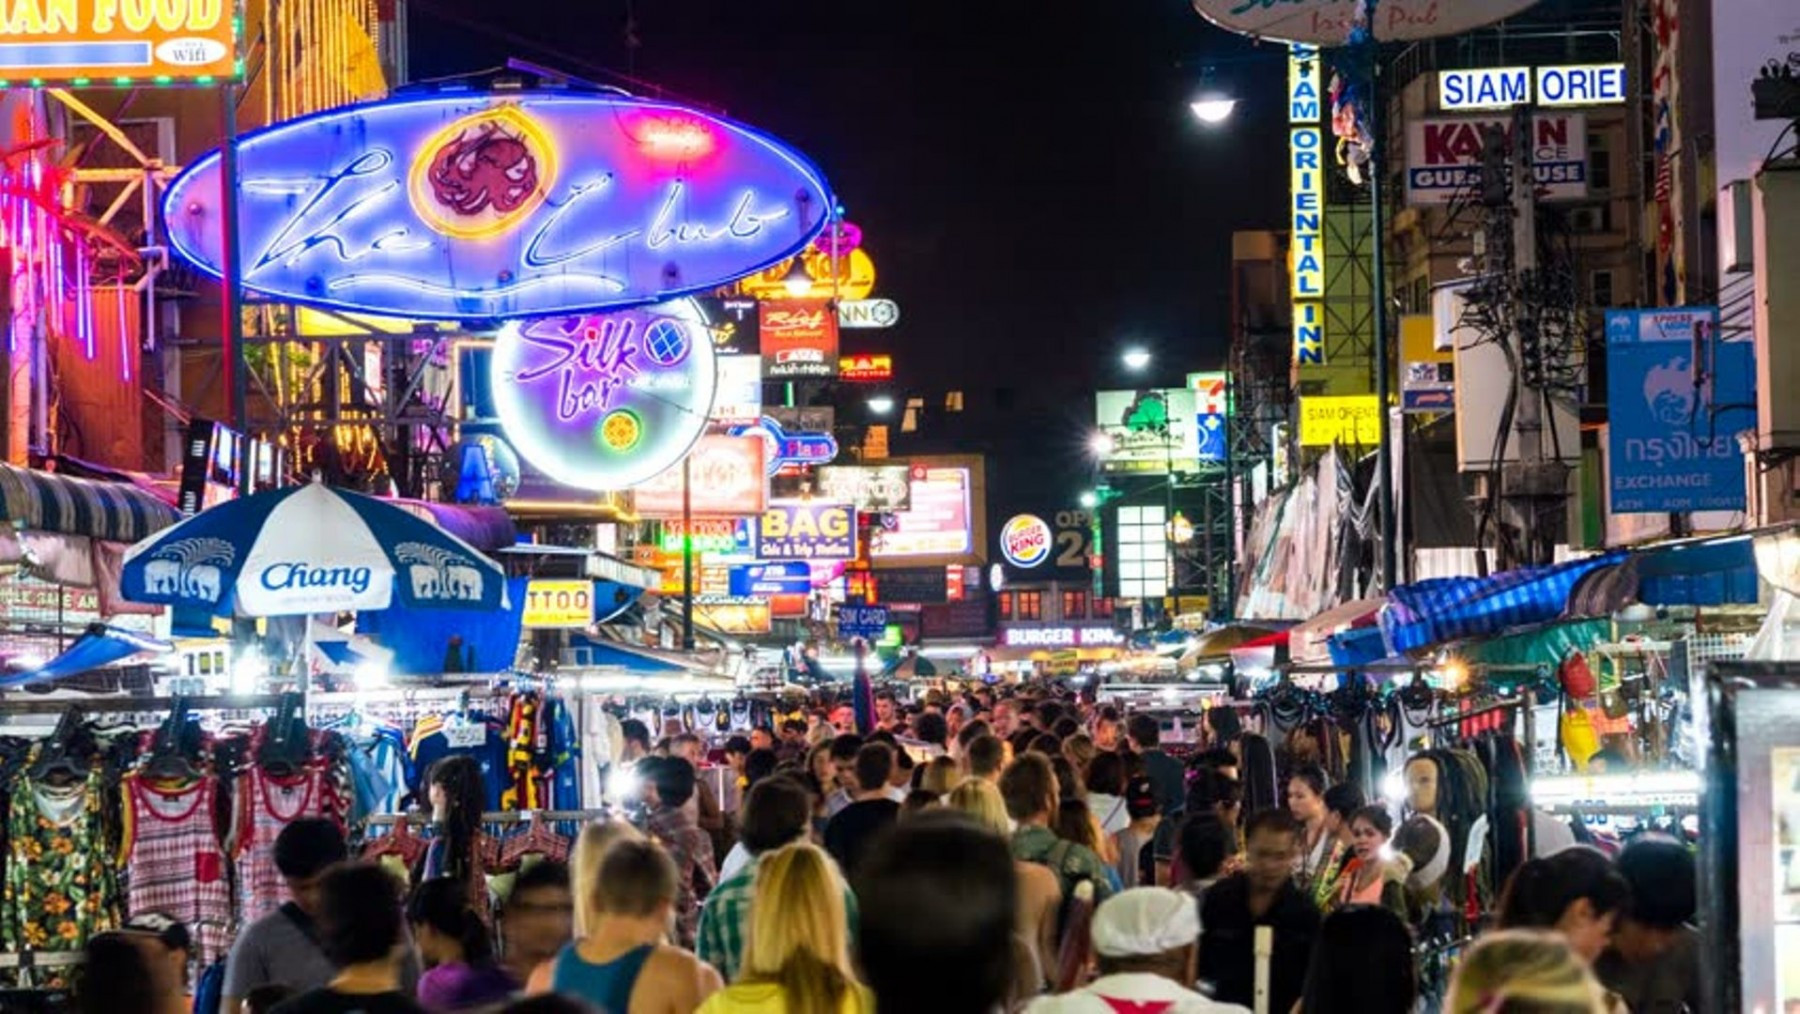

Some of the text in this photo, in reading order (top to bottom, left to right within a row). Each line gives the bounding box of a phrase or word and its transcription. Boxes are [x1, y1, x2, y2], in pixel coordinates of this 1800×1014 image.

[92, 0, 222, 33] FOOD
[1444, 71, 1526, 105] SIAM
[236, 147, 791, 280] The Club
[1293, 129, 1320, 293] ORIENTAL
[517, 316, 641, 383] Silk
[1298, 305, 1323, 365] INN
[557, 368, 621, 423] bar
[1613, 473, 1713, 490] EXCHANGE
[761, 506, 849, 538] BAG
[1009, 533, 1045, 554] KING
[259, 561, 371, 594] Chang
[1006, 627, 1074, 645] BURGER
